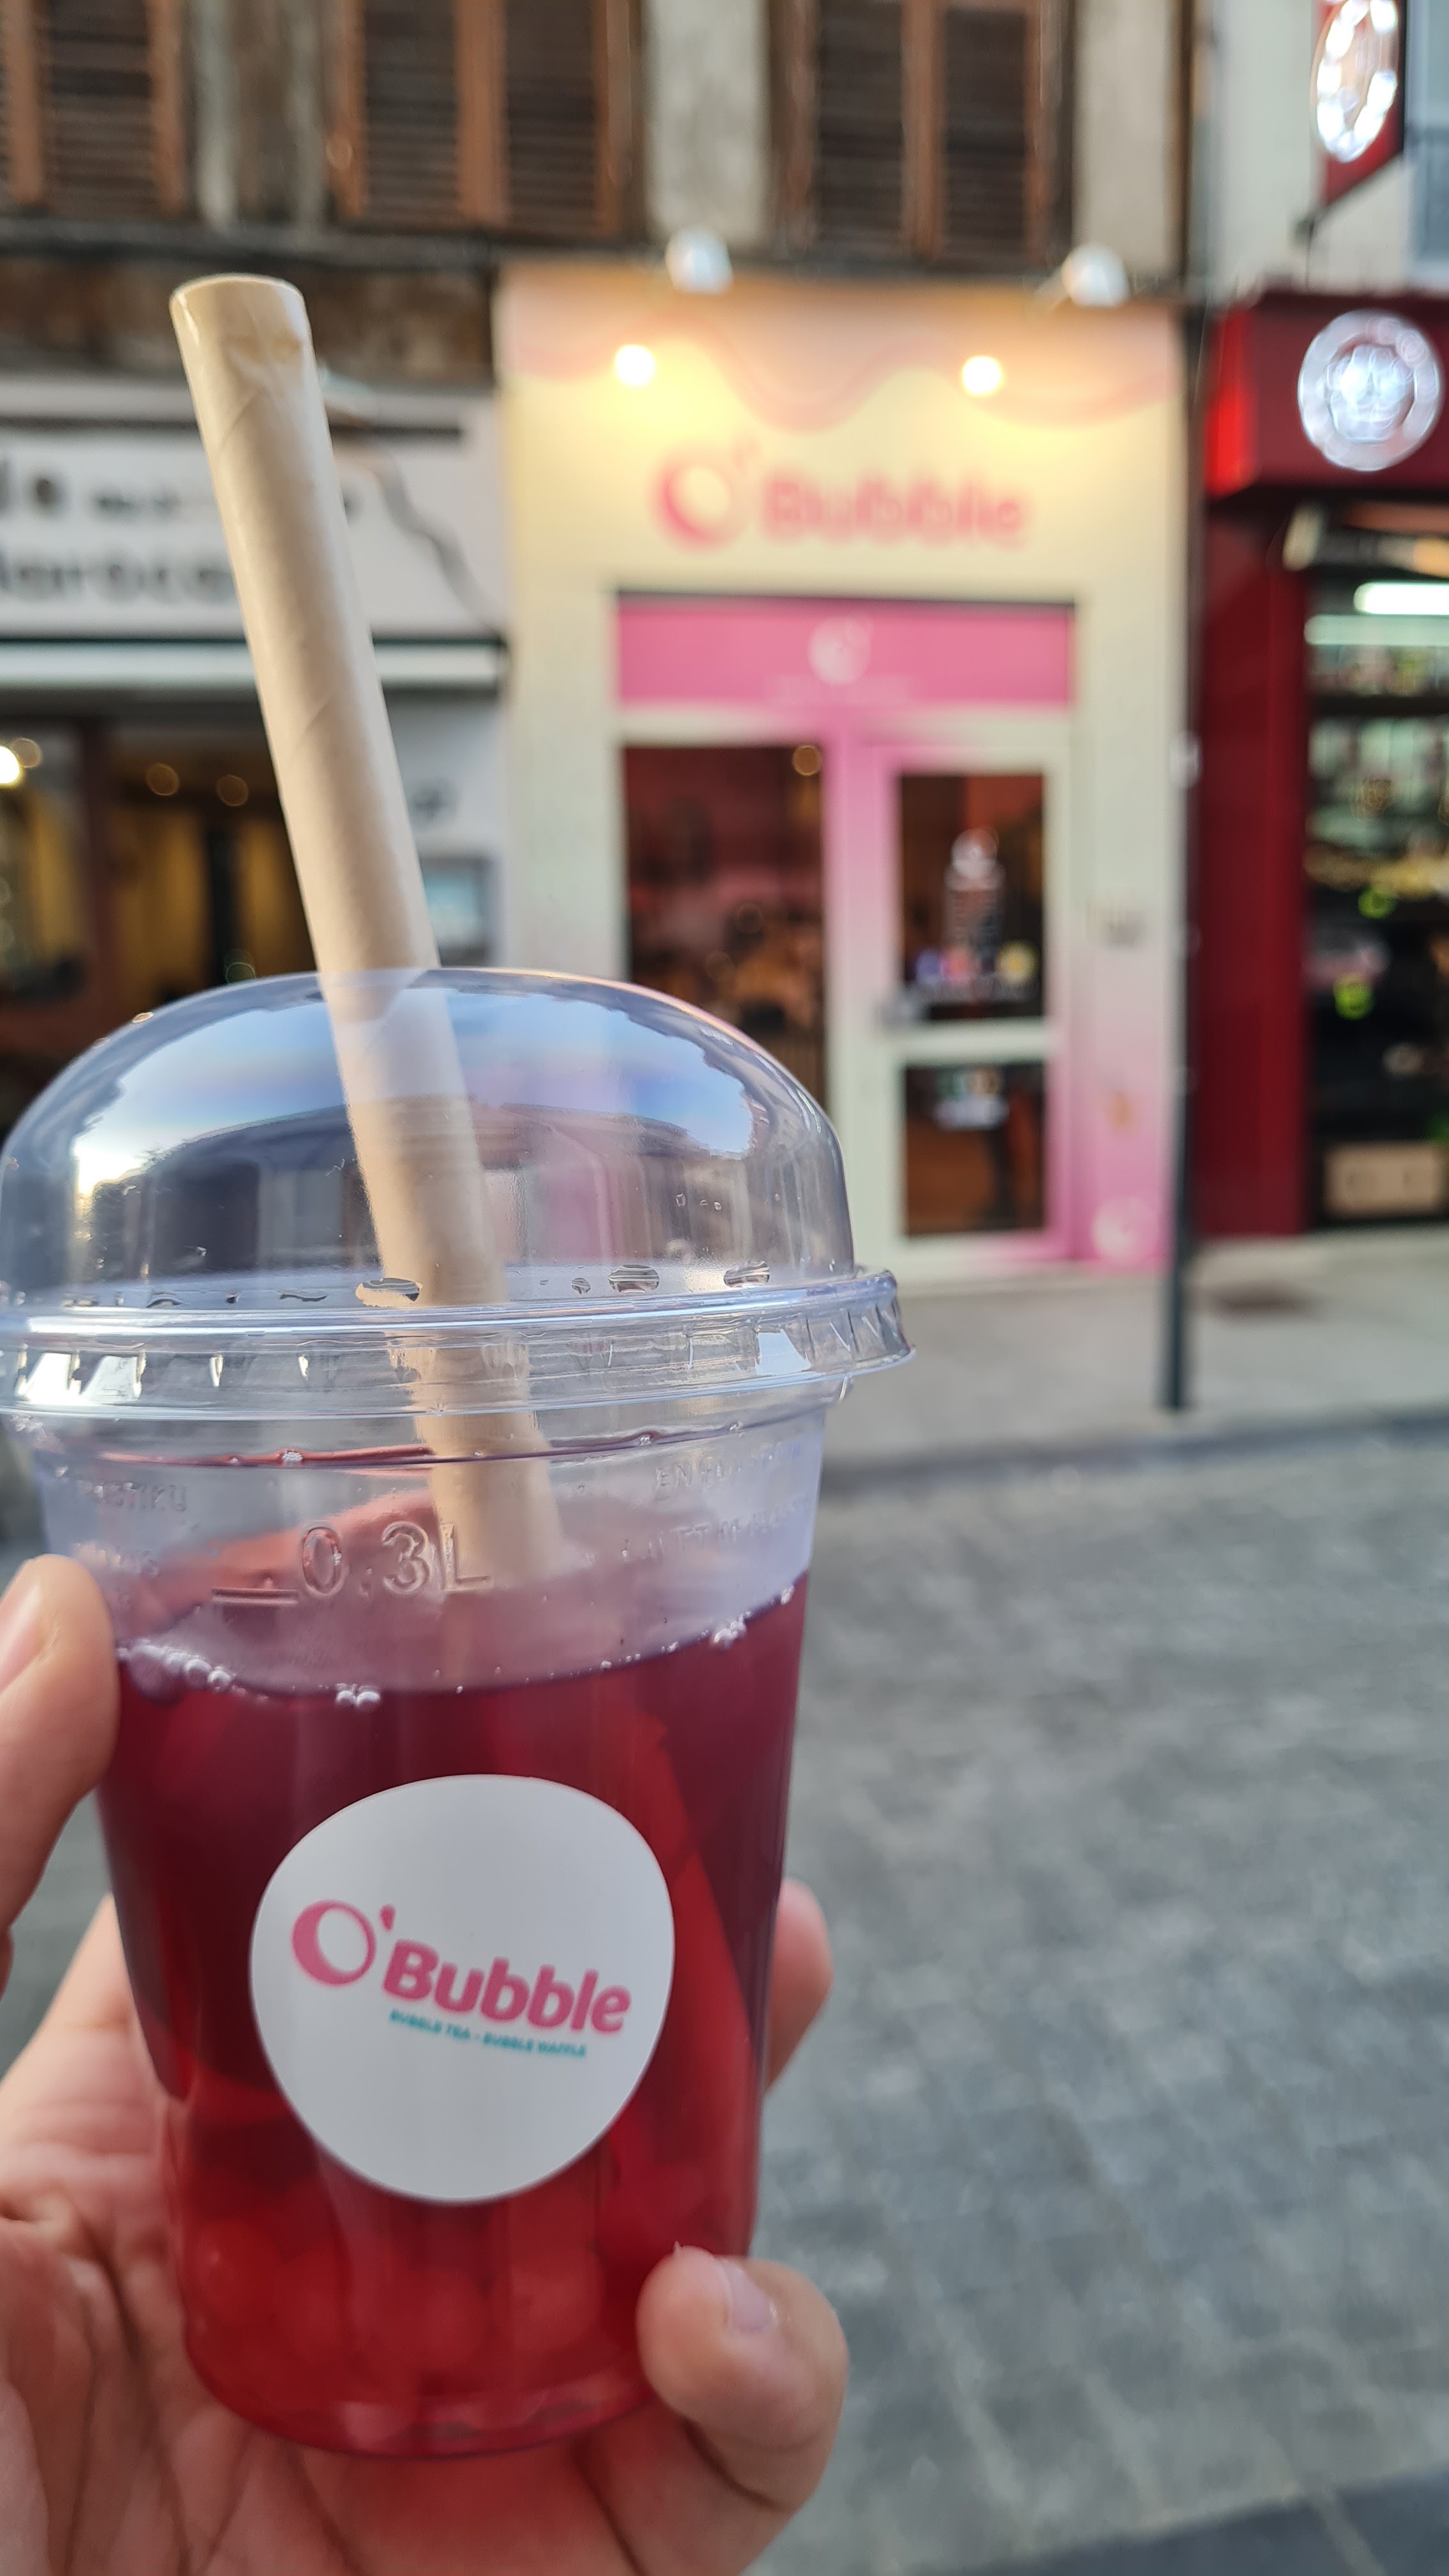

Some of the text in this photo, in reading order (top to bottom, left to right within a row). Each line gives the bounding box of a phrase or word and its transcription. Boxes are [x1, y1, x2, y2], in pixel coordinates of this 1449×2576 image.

[291, 1901, 631, 2035] O'Bubble
[389, 2009, 443, 2035] BUBBLE
[446, 2023, 471, 2039] TEA
[483, 2030, 533, 2052] BUBBLE
